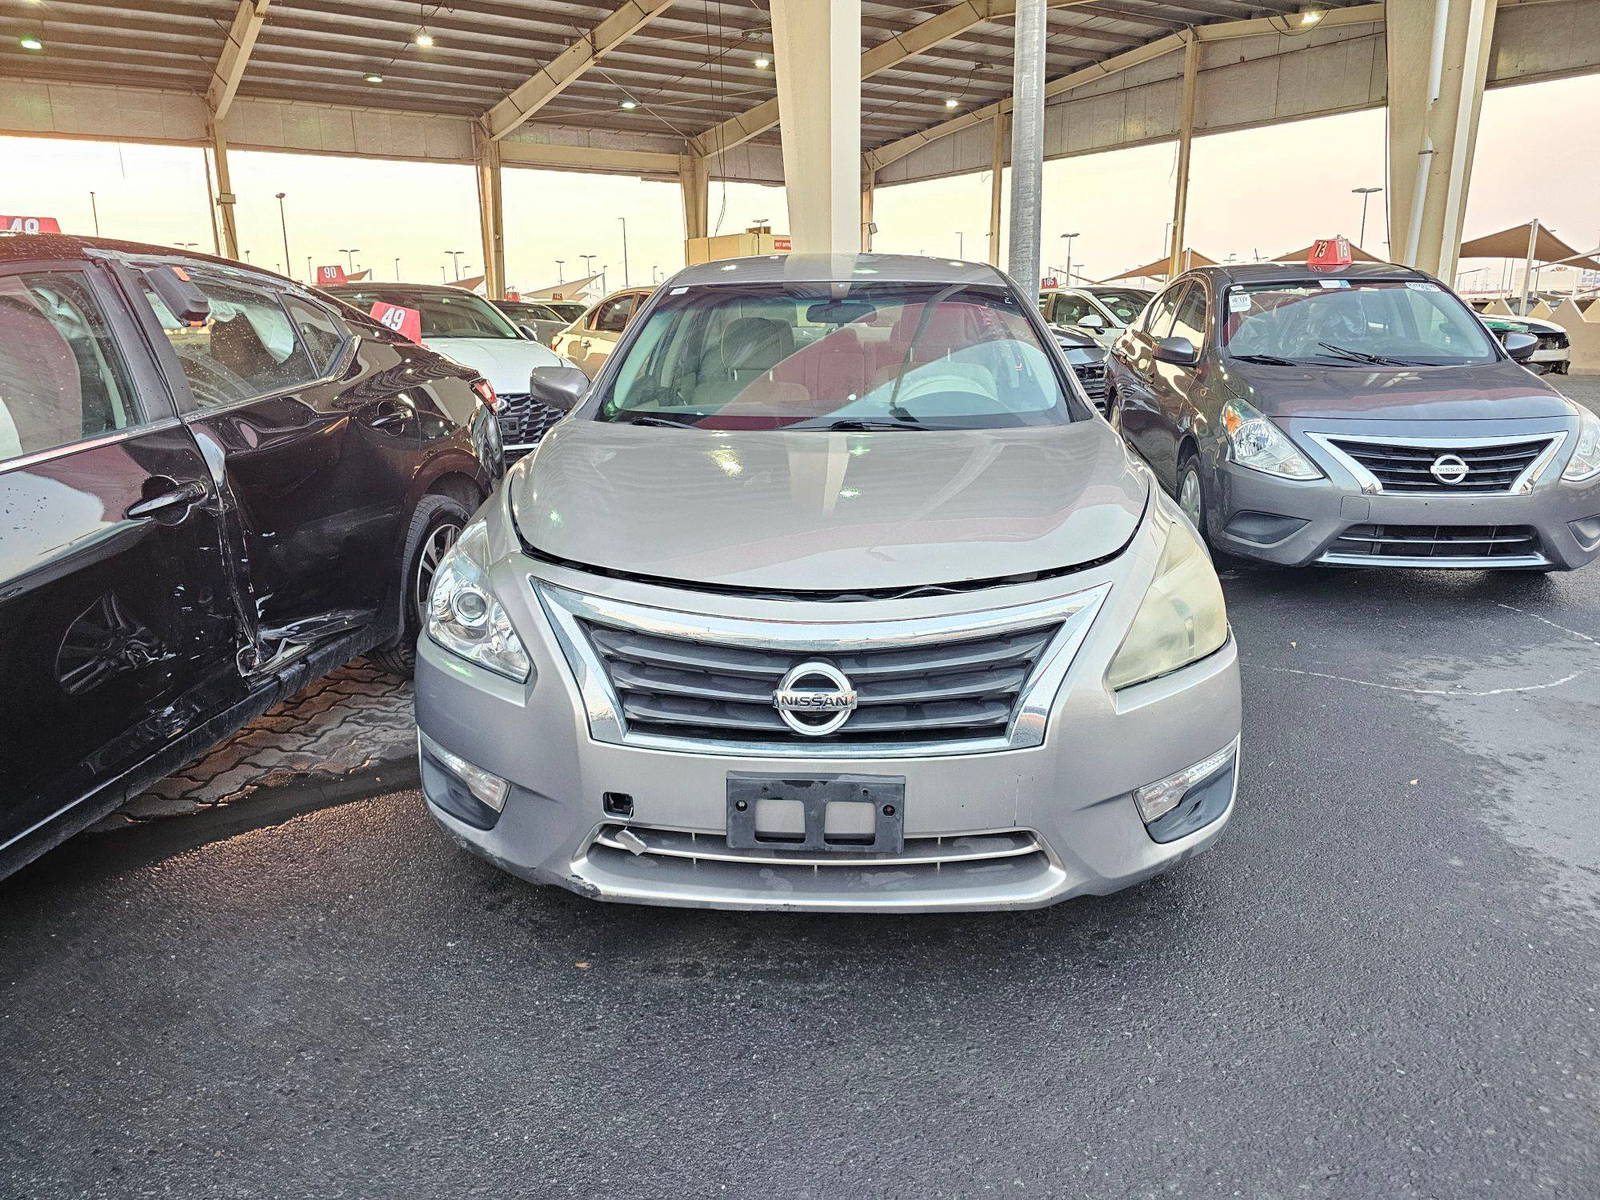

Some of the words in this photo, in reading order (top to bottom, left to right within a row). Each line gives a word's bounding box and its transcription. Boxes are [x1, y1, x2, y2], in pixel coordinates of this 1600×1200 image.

[1314, 241, 1328, 258] 73
[324, 267, 336, 278] 90
[381, 307, 406, 331] 49
[781, 695, 848, 707] NISSAN
